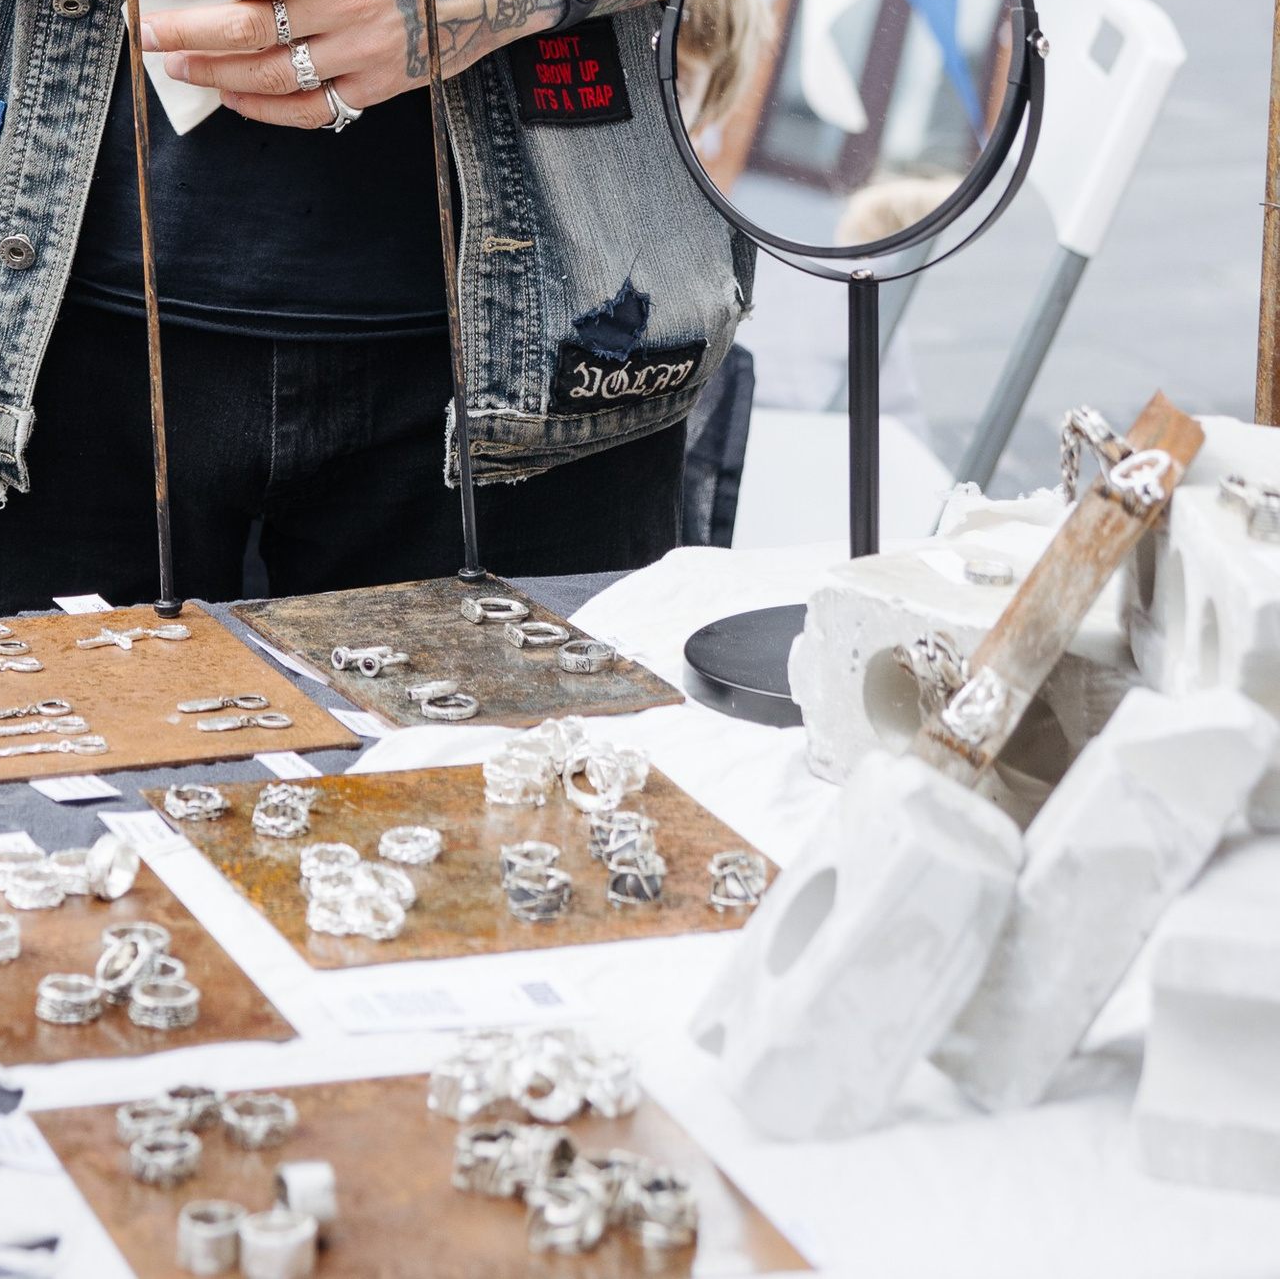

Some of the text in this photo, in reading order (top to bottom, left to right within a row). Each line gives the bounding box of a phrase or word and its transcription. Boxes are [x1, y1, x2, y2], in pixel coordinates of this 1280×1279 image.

[539, 36, 580, 60] DON'T
[536, 60, 600, 84] GROW UP
[533, 85, 613, 111] IT'S A TRAP
